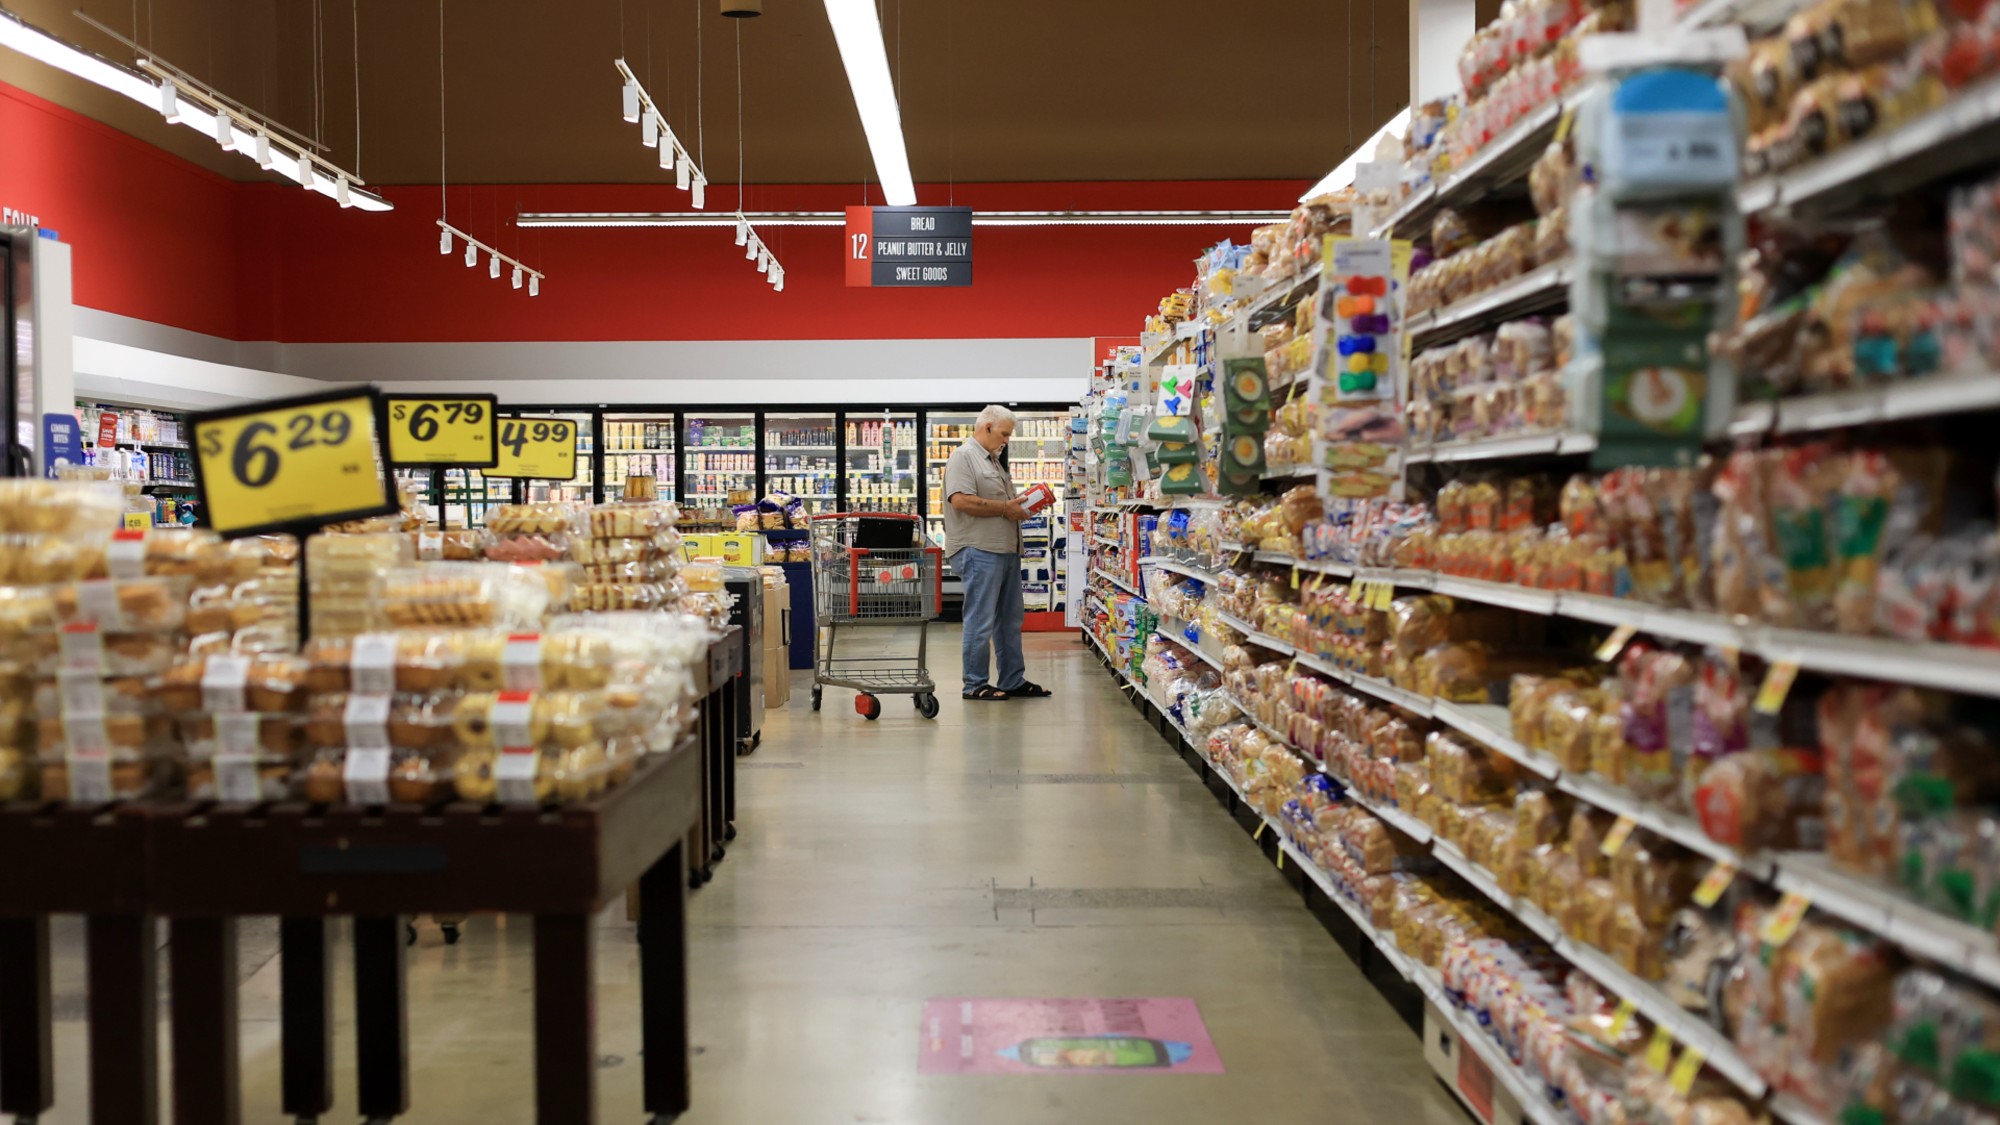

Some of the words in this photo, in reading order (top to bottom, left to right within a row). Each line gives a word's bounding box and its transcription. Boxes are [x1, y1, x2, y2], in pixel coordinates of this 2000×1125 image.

[910, 217, 935, 231] BREAD
[851, 233, 868, 260] 12
[877, 242, 906, 256] PEANUT
[907, 242, 935, 256] BUTTER
[936, 243, 943, 256] &
[944, 242, 968, 256] JELLY
[896, 267, 920, 281] SWEET
[922, 267, 948, 281] GOODS
